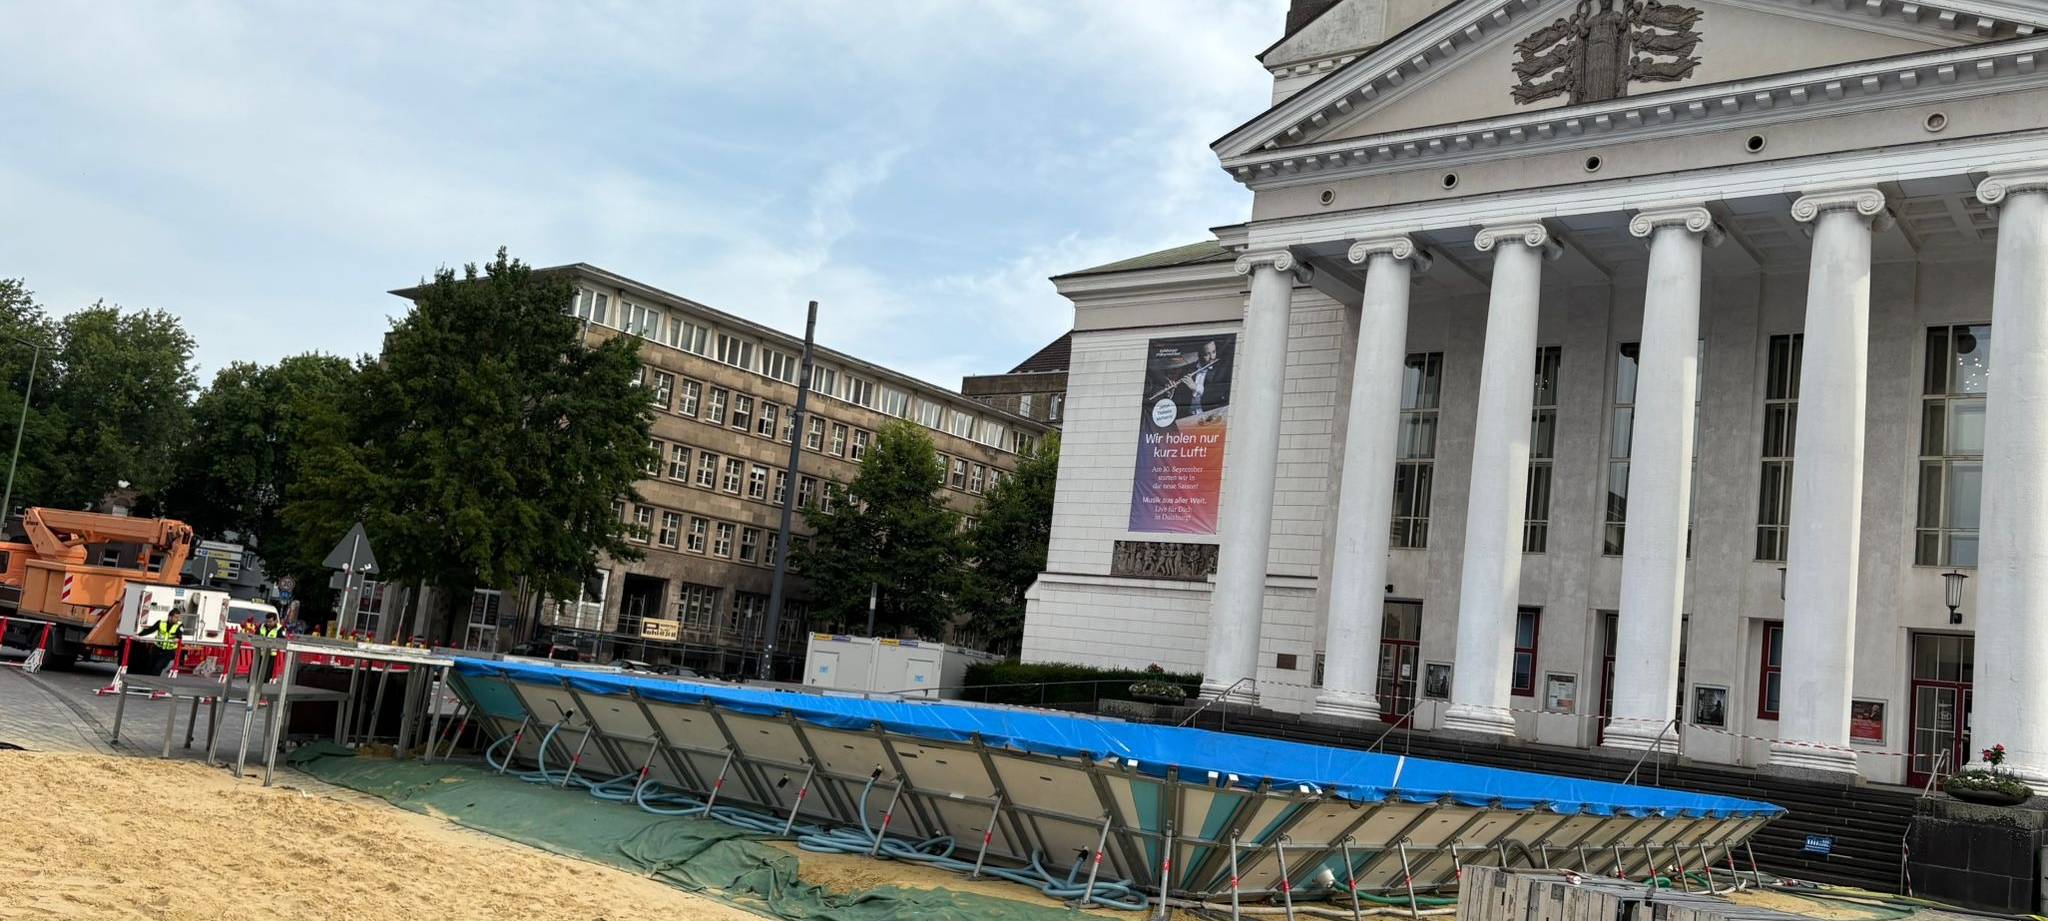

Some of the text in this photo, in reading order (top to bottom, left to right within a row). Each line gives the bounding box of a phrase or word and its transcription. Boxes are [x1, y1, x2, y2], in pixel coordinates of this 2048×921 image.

[1146, 432, 1219, 444] Wir holen nur
[1153, 447, 1207, 458] kurz Luft!
